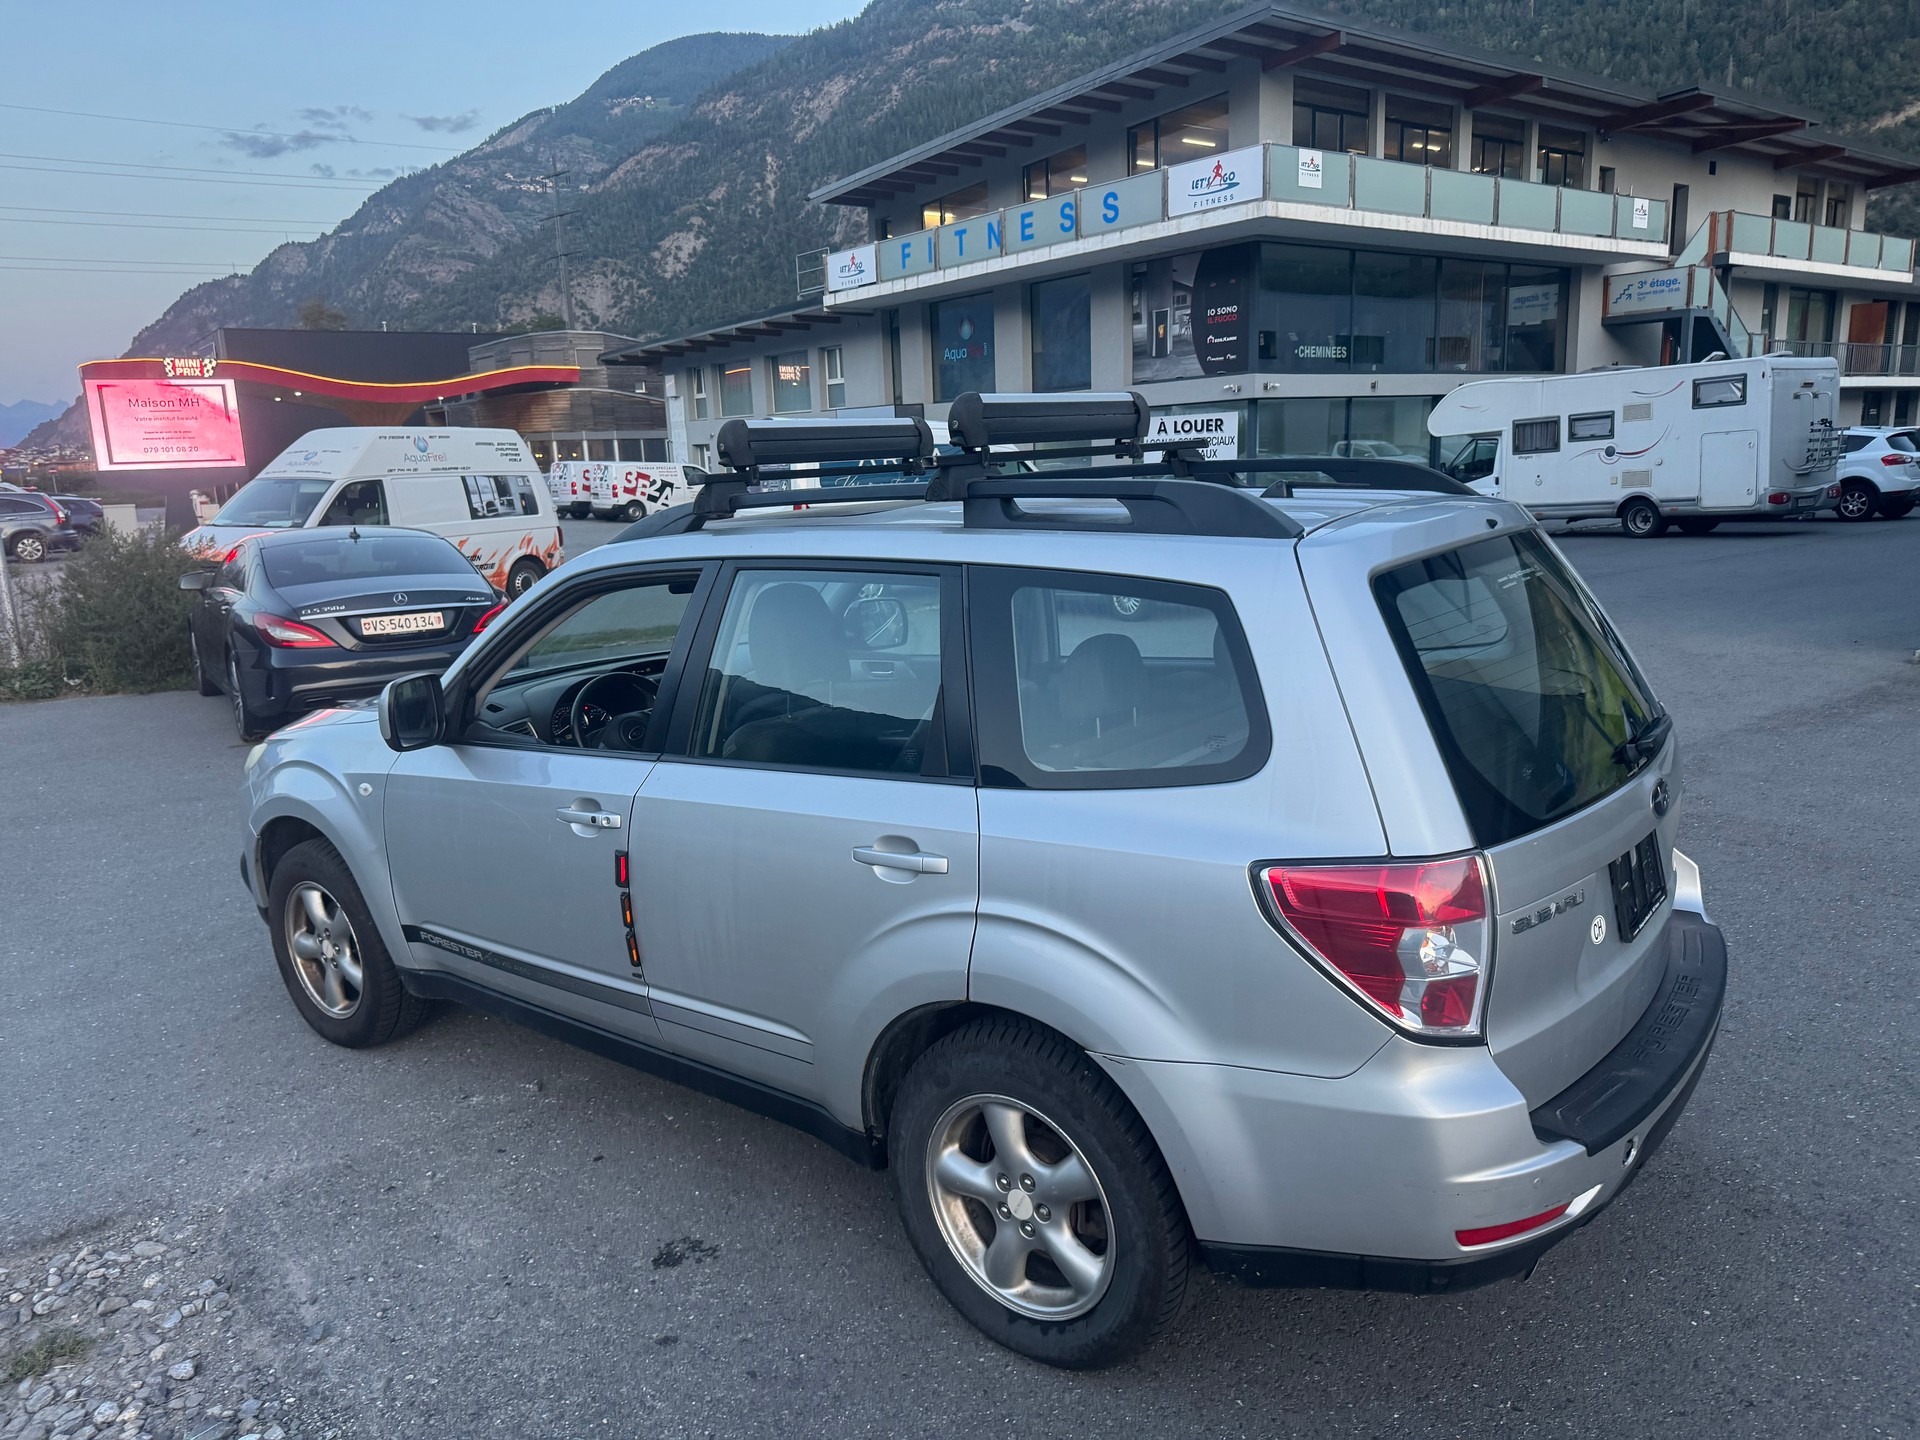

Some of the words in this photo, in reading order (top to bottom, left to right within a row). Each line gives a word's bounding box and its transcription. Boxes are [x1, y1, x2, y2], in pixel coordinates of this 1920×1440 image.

[1191, 176, 1211, 190] LET'S
[1222, 171, 1236, 183] GO
[1193, 193, 1234, 208] FITNESS
[901, 191, 1120, 269] FITNESS
[1207, 308, 1216, 316] IO
[1216, 305, 1238, 315] SONO
[1214, 313, 1238, 323] FUOCO
[1298, 345, 1347, 359] CHEMINEES
[175, 358, 201, 368] MINI
[175, 367, 202, 376] PRIX
[128, 398, 175, 408] Maison
[178, 398, 200, 407] MH
[1157, 418, 1168, 435] À
[1173, 418, 1224, 434] LOUER
[403, 452, 444, 464] AquaFire
[1511, 889, 1585, 935] SUBARU
[420, 931, 484, 961] FORESTER
